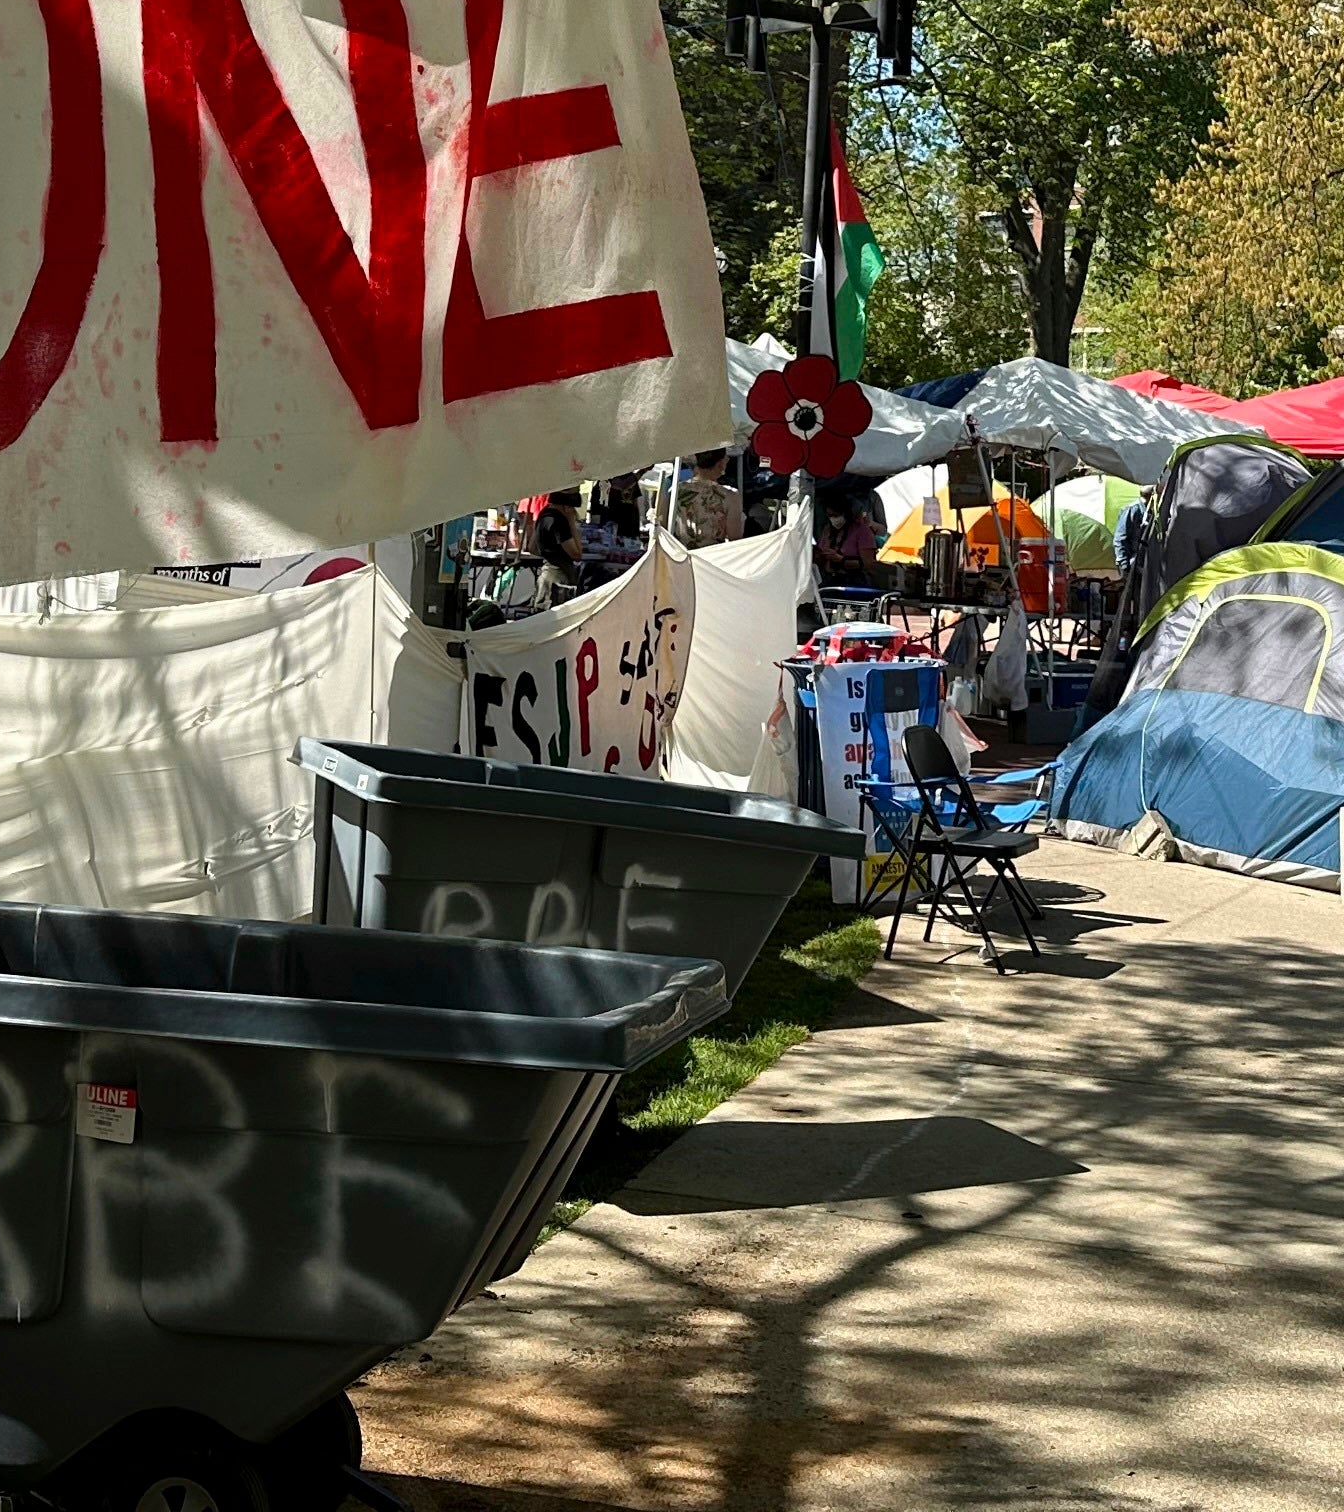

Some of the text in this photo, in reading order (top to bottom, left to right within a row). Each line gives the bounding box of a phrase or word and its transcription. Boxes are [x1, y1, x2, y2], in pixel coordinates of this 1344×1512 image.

[156, 567, 229, 585] months of
[871, 862, 906, 876] AMESTY
[87, 1086, 128, 1106] ULINE
